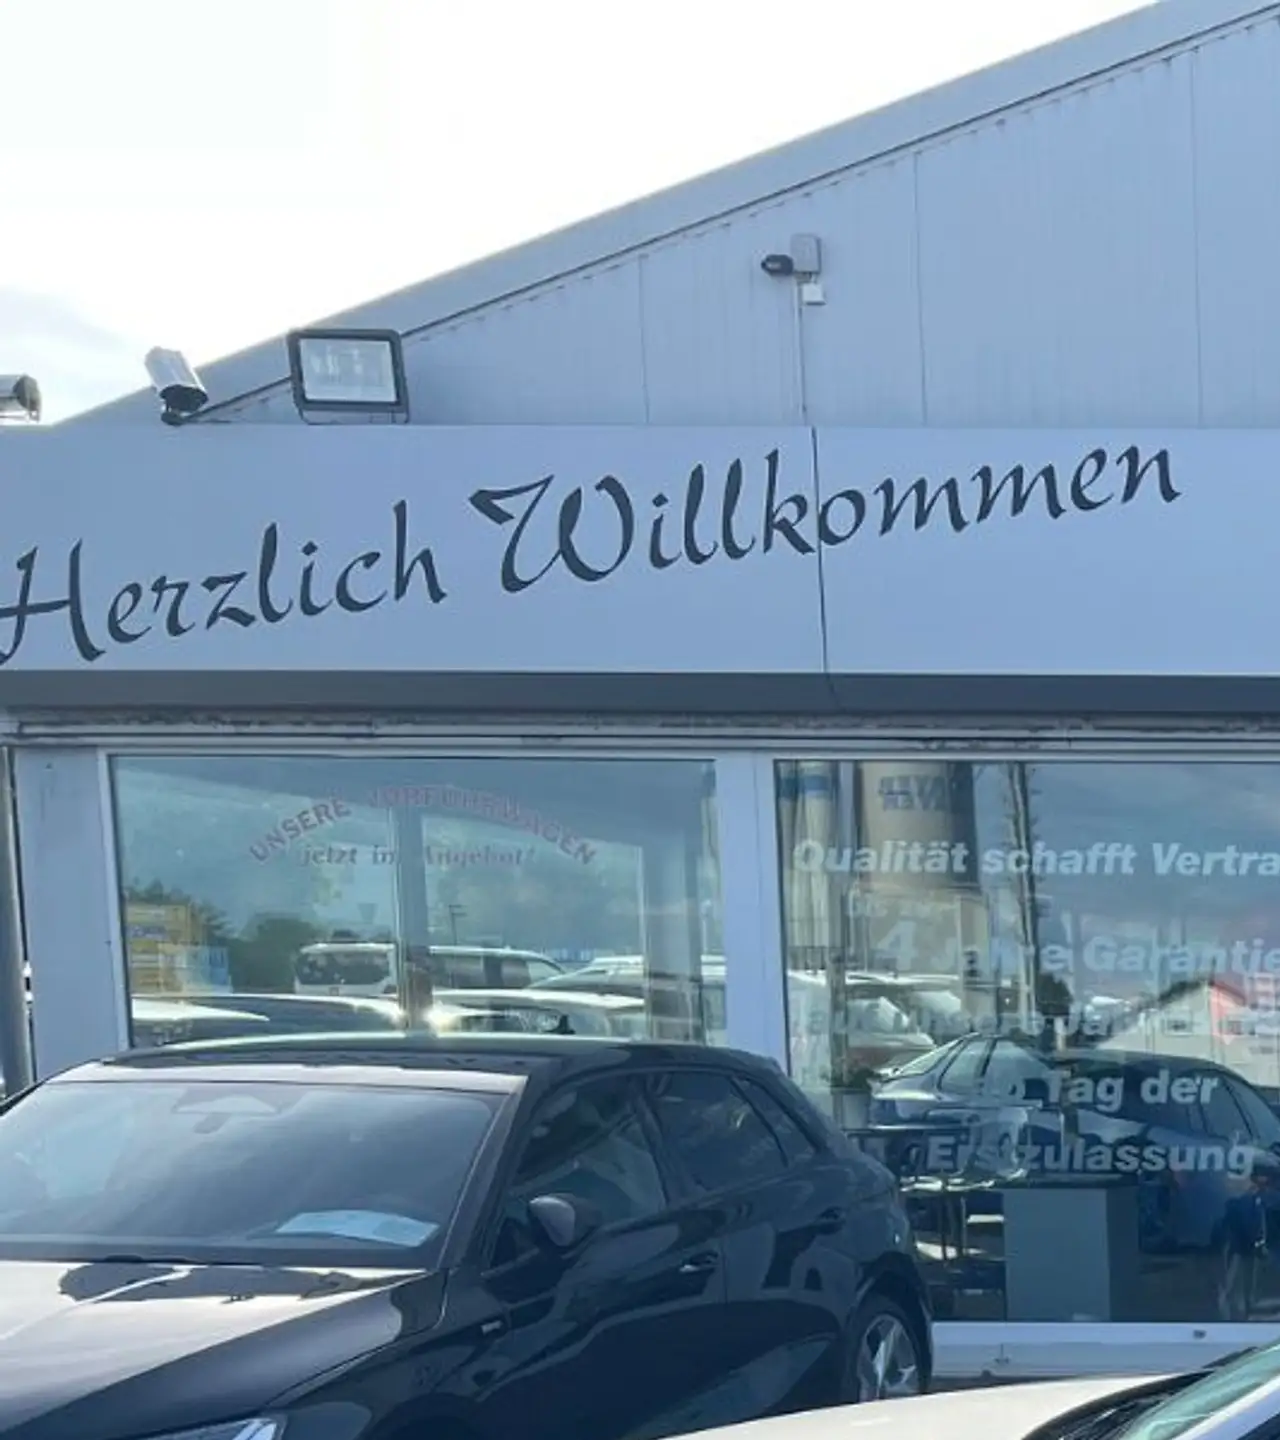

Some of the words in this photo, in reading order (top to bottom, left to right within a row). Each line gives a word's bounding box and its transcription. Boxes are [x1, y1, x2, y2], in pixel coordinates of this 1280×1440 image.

[0, 500, 447, 667] Herzlich
[468, 443, 1181, 593] Willkommen
[792, 837, 970, 874] Qualität
[981, 838, 1134, 875] schafft
[1045, 1068, 1124, 1113] Tag
[1140, 1069, 1219, 1105] der
